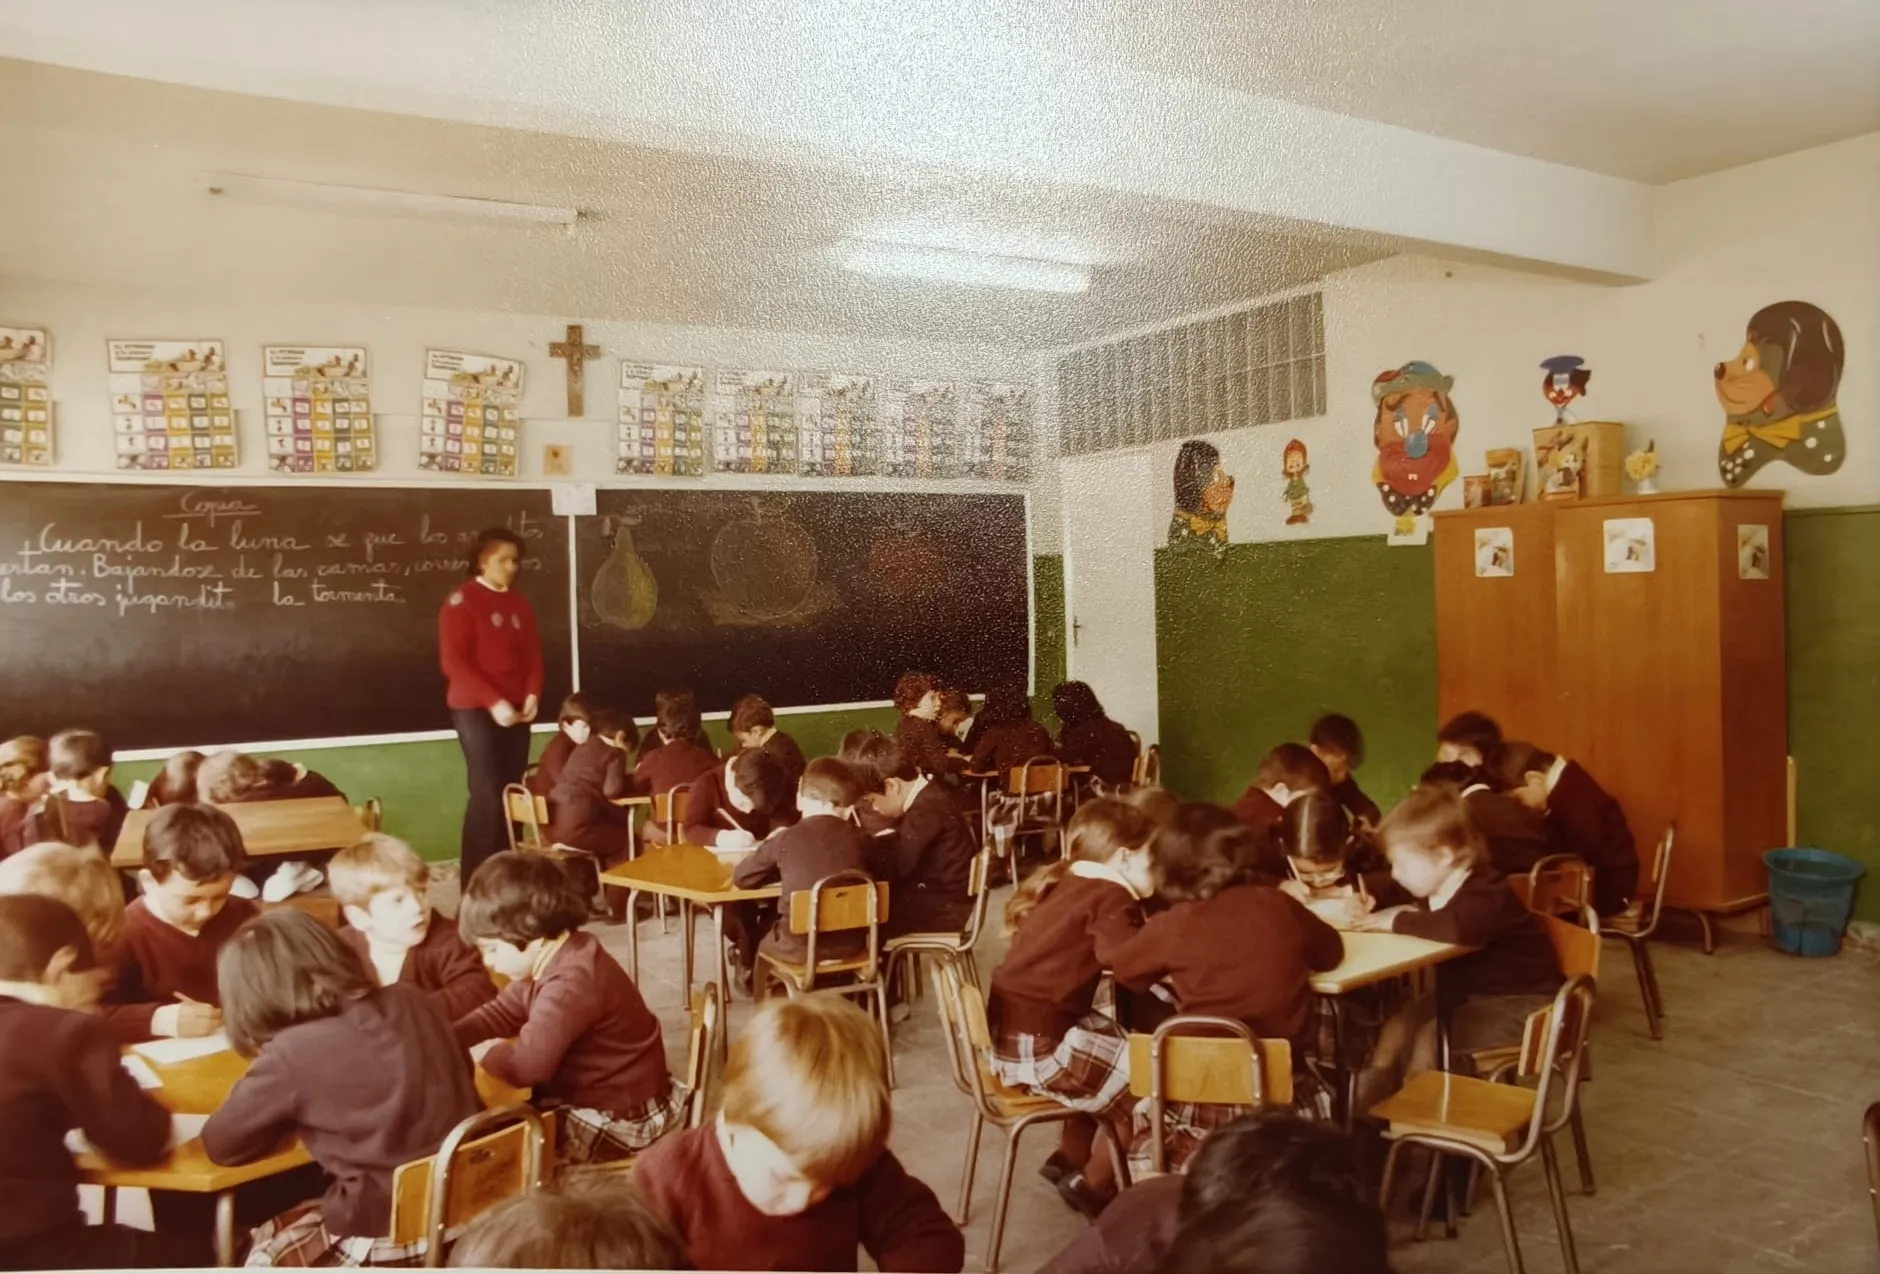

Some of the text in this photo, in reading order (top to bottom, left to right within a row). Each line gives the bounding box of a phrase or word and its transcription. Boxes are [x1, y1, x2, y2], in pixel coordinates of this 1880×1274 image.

[39, 520, 163, 553] Cuando
[177, 521, 219, 552] la
[230, 518, 312, 551] luna
[46, 577, 107, 606] otros
